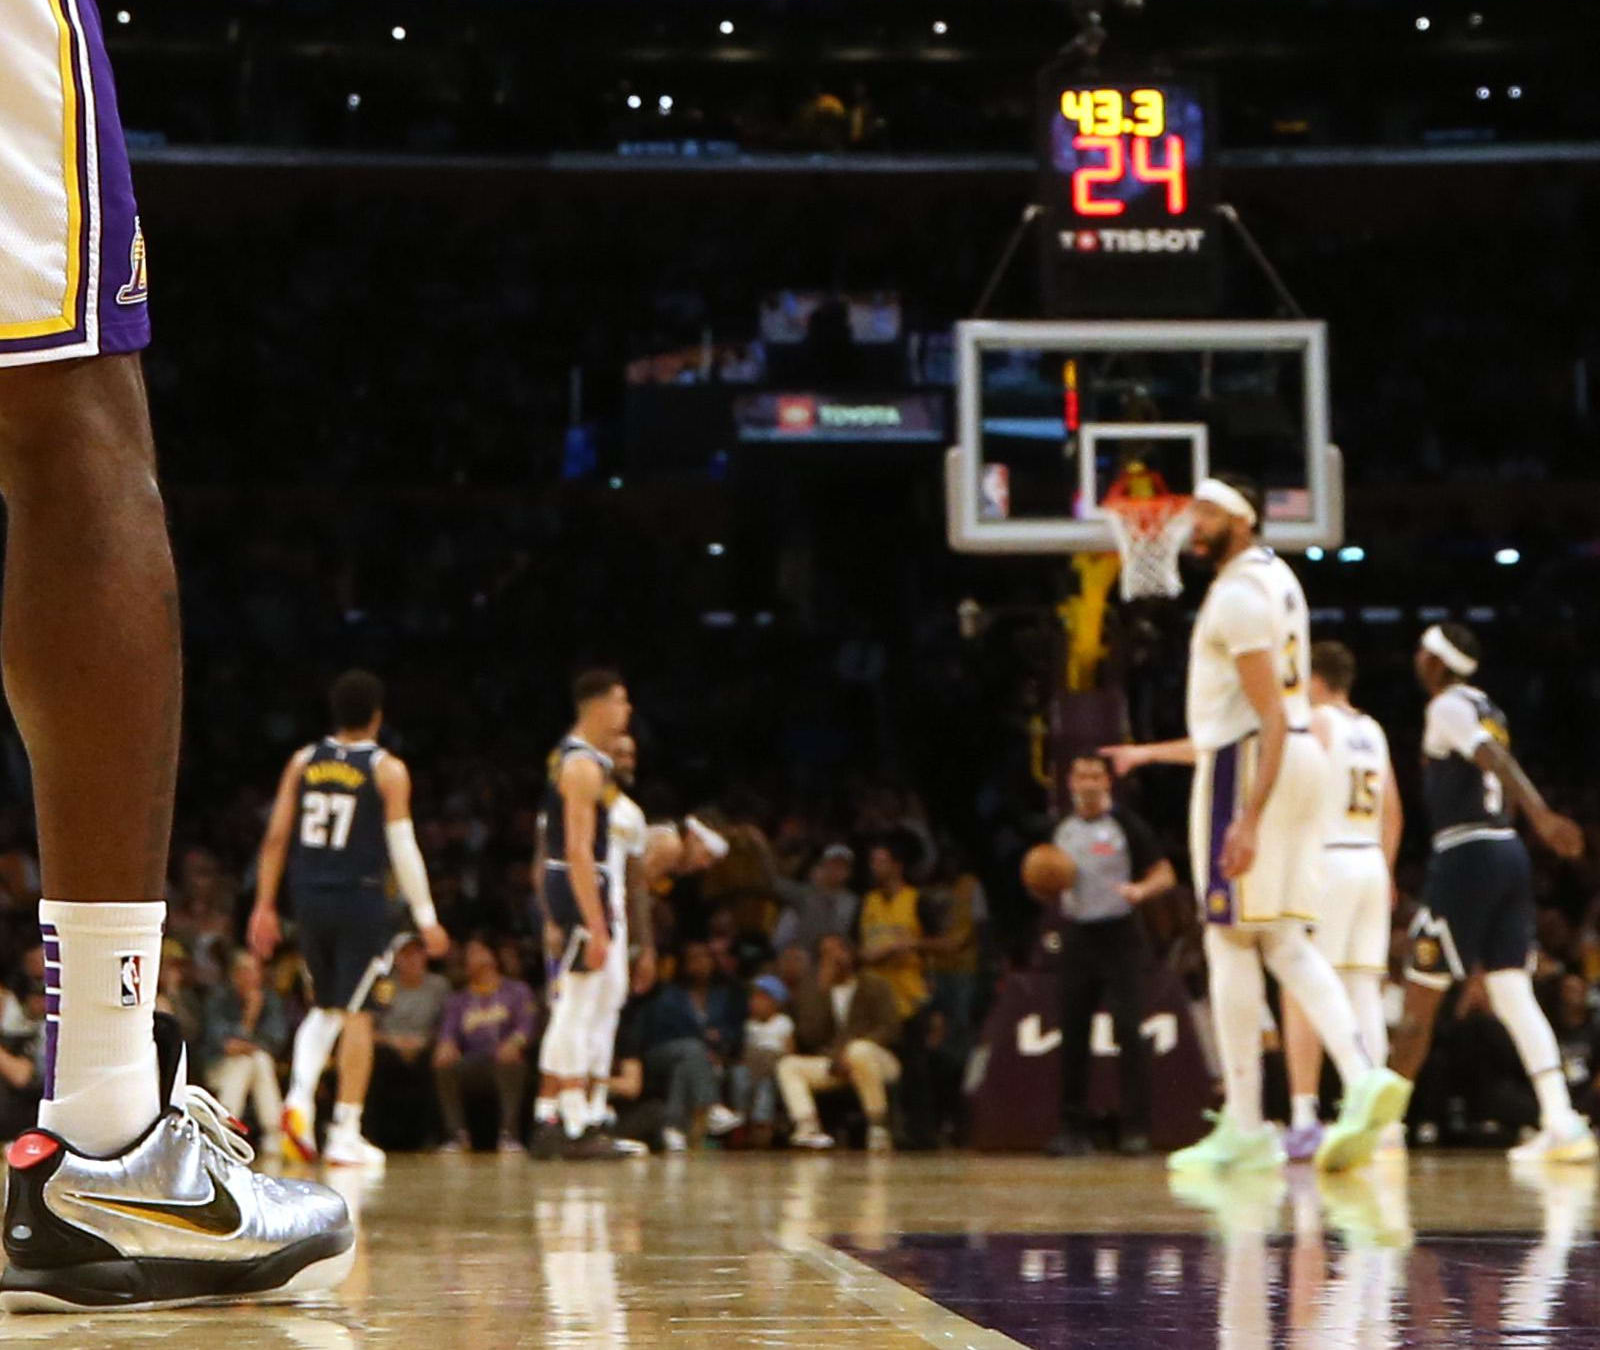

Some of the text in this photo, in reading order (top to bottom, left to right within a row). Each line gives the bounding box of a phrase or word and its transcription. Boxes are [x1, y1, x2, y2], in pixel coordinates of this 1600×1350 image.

[1060, 89, 1165, 137] 43.3
[1071, 134, 1188, 217] 24
[1099, 229, 1205, 253] TISSOT
[300, 791, 357, 850] 27
[1343, 767, 1377, 821] 15
